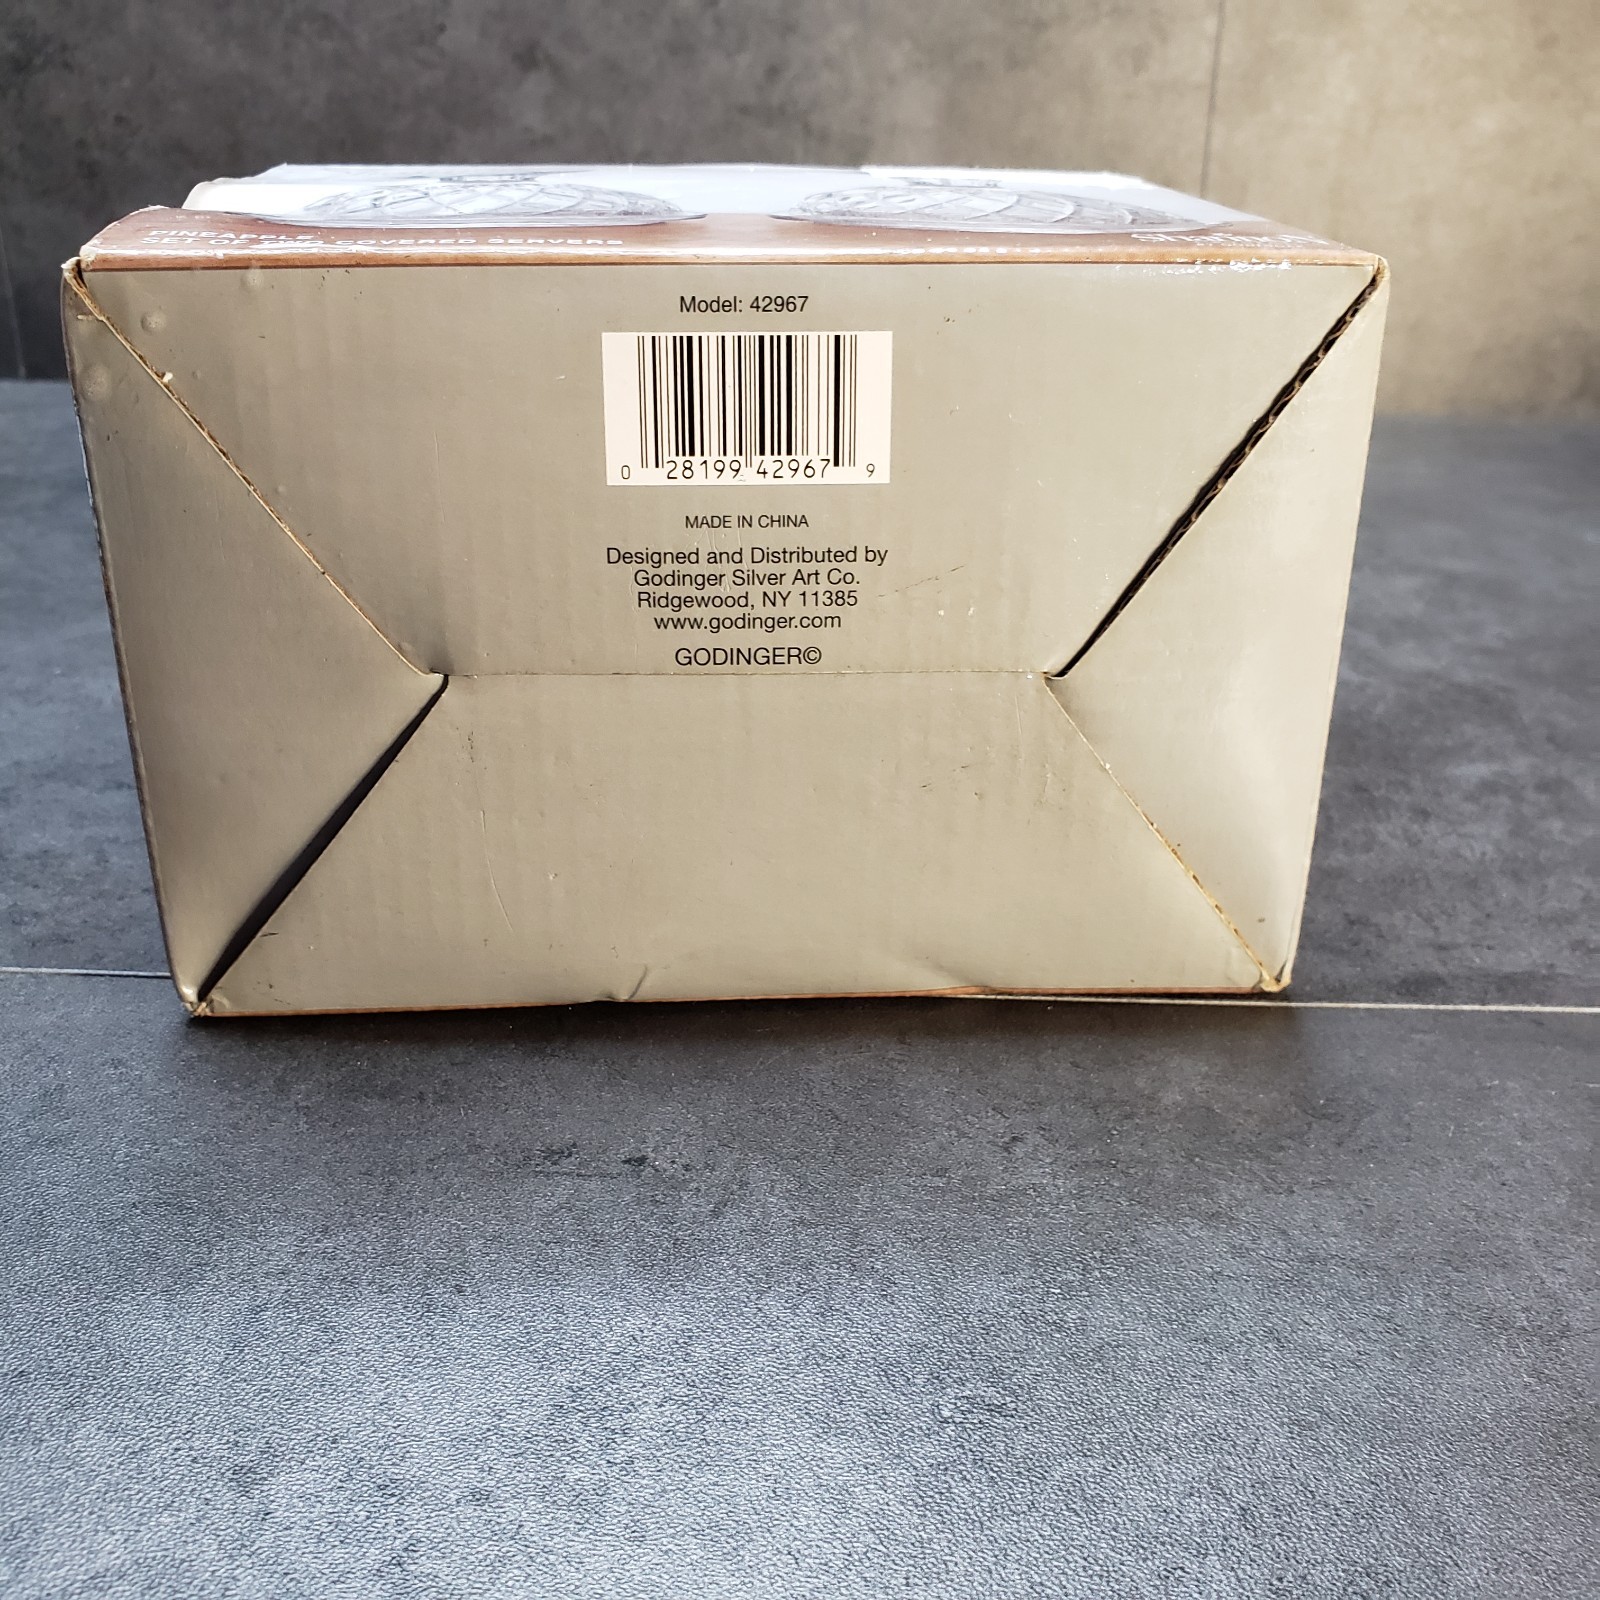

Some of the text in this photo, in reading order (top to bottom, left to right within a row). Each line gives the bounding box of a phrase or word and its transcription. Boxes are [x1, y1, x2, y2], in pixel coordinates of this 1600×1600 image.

[149, 230, 315, 240] PINEAPPLE
[679, 295, 809, 313] Model: 42967
[620, 459, 876, 480] 0 28199 42967 9
[685, 514, 809, 529] MADE IN CHINA
[606, 546, 888, 568] Designed and Distributed by
[633, 568, 861, 591] Godinger Silver Art Co.
[637, 590, 858, 612] Ridgewood, NY 11385
[654, 613, 842, 633] www.godinger.com
